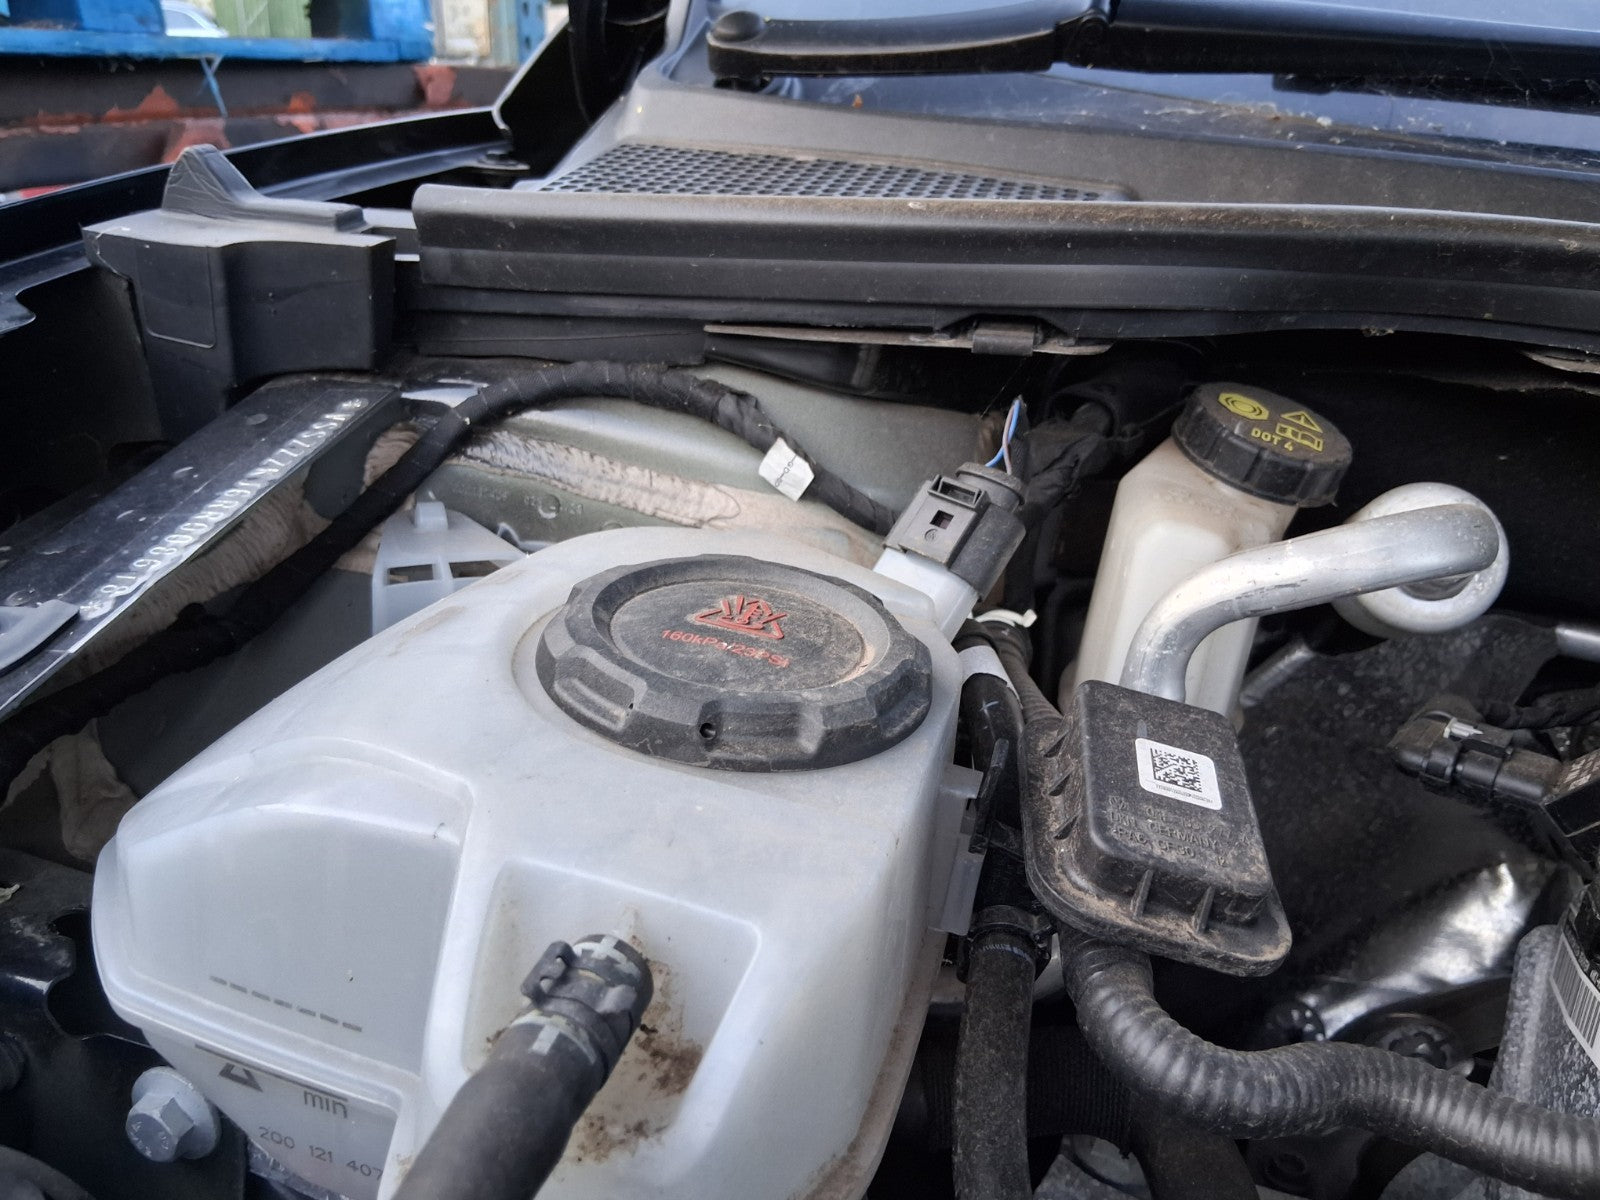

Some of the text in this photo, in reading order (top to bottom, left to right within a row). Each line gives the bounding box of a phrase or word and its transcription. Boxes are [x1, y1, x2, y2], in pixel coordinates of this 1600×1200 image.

[1251, 428, 1294, 452] DOT 4
[303, 1090, 349, 1119] min
[258, 1126, 383, 1180] 200 121 407
